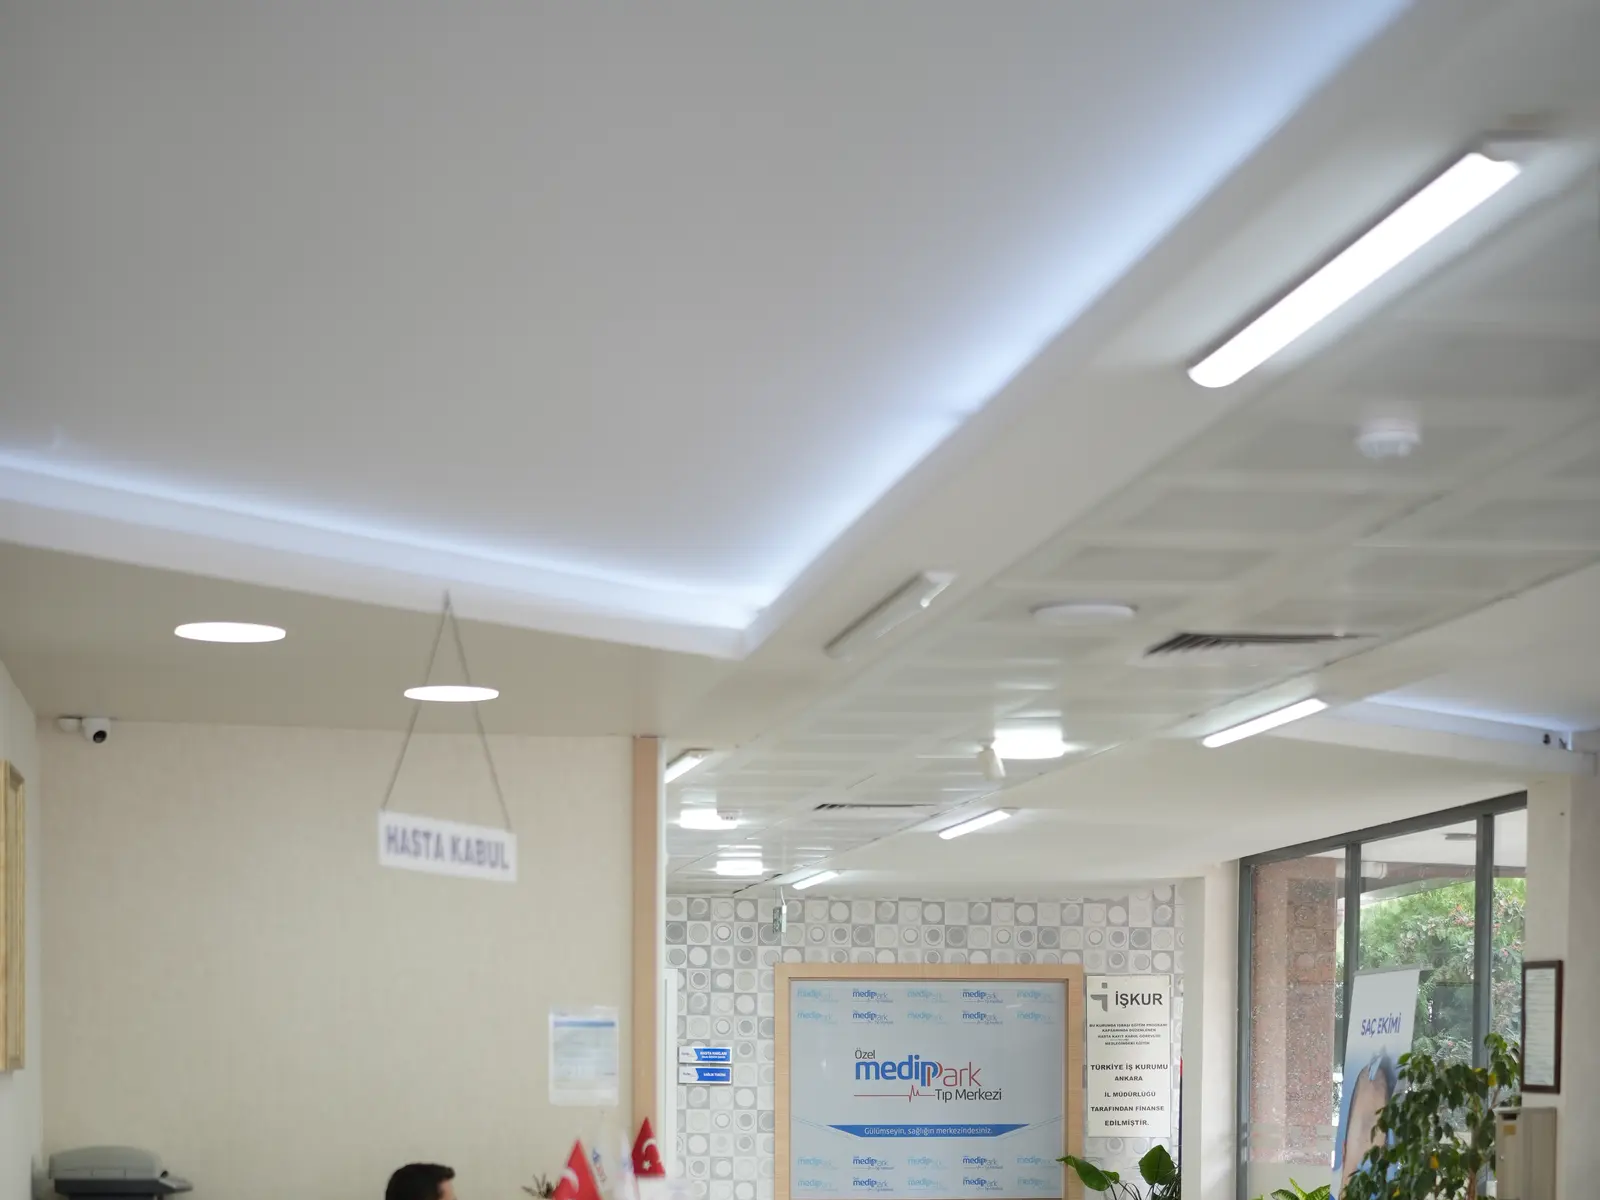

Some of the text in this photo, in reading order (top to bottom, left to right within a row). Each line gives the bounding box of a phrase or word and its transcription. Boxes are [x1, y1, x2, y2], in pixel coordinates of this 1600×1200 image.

[385, 824, 511, 871] HASTA KABUL
[1115, 991, 1163, 1009] İŞKUR
[1361, 1012, 1402, 1038] SAÇ EKİMİ
[855, 1047, 876, 1059] Özel
[935, 1088, 1002, 1103] Tıp Merkezi
[1112, 1090, 1156, 1098] MÜDÜRLÜĞÜ
[1104, 1119, 1150, 1127] EDİLMİŞTİR.
[935, 1127, 993, 1135] merkezindesiniz.
